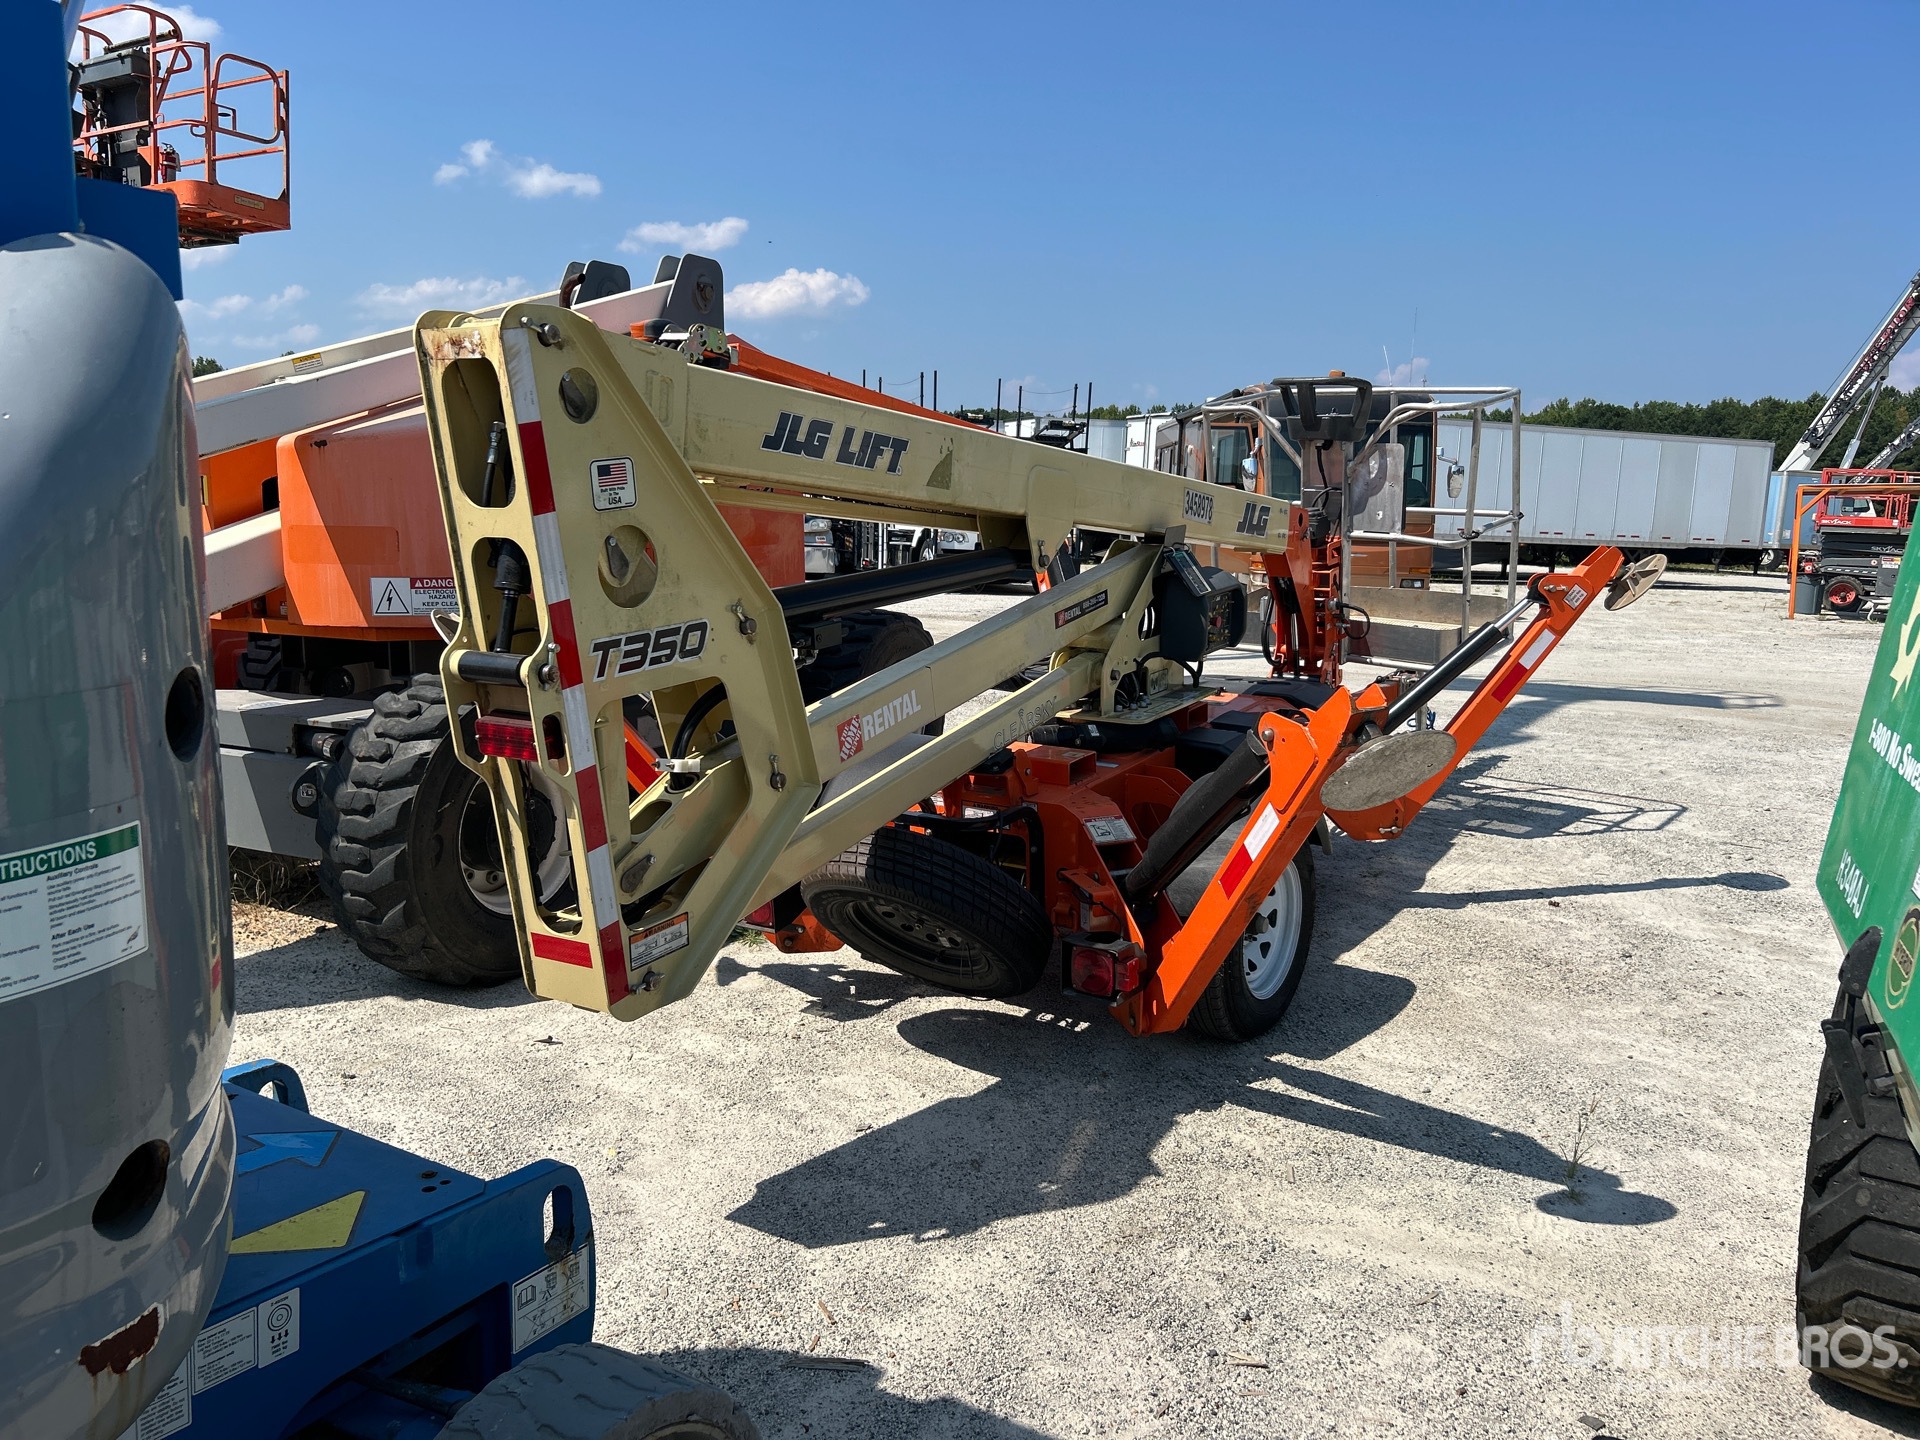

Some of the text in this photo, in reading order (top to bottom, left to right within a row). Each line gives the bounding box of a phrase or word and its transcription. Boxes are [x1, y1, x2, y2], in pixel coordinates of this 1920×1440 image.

[760, 410, 910, 475] JLG LIFT
[608, 496, 622, 505] USA
[1185, 490, 1214, 521] 3458978
[1236, 501, 1271, 538] JLG
[1871, 545, 1905, 553] SKYJAC
[424, 579, 455, 587] DANG
[1065, 605, 1081, 621] RENTAL
[590, 619, 709, 681] T350
[863, 689, 921, 742] RENTAL
[994, 694, 1058, 750] CLEARSKY
[840, 716, 860, 760] HOME
[841, 724, 849, 741] THE
[850, 729, 862, 756] DEPOT
[1868, 718, 1920, 793] 1-800 No Swea
[0, 842, 97, 880] TRUCTIONS
[51, 923, 95, 940] After Each Use
[648, 920, 675, 936] WARNING
